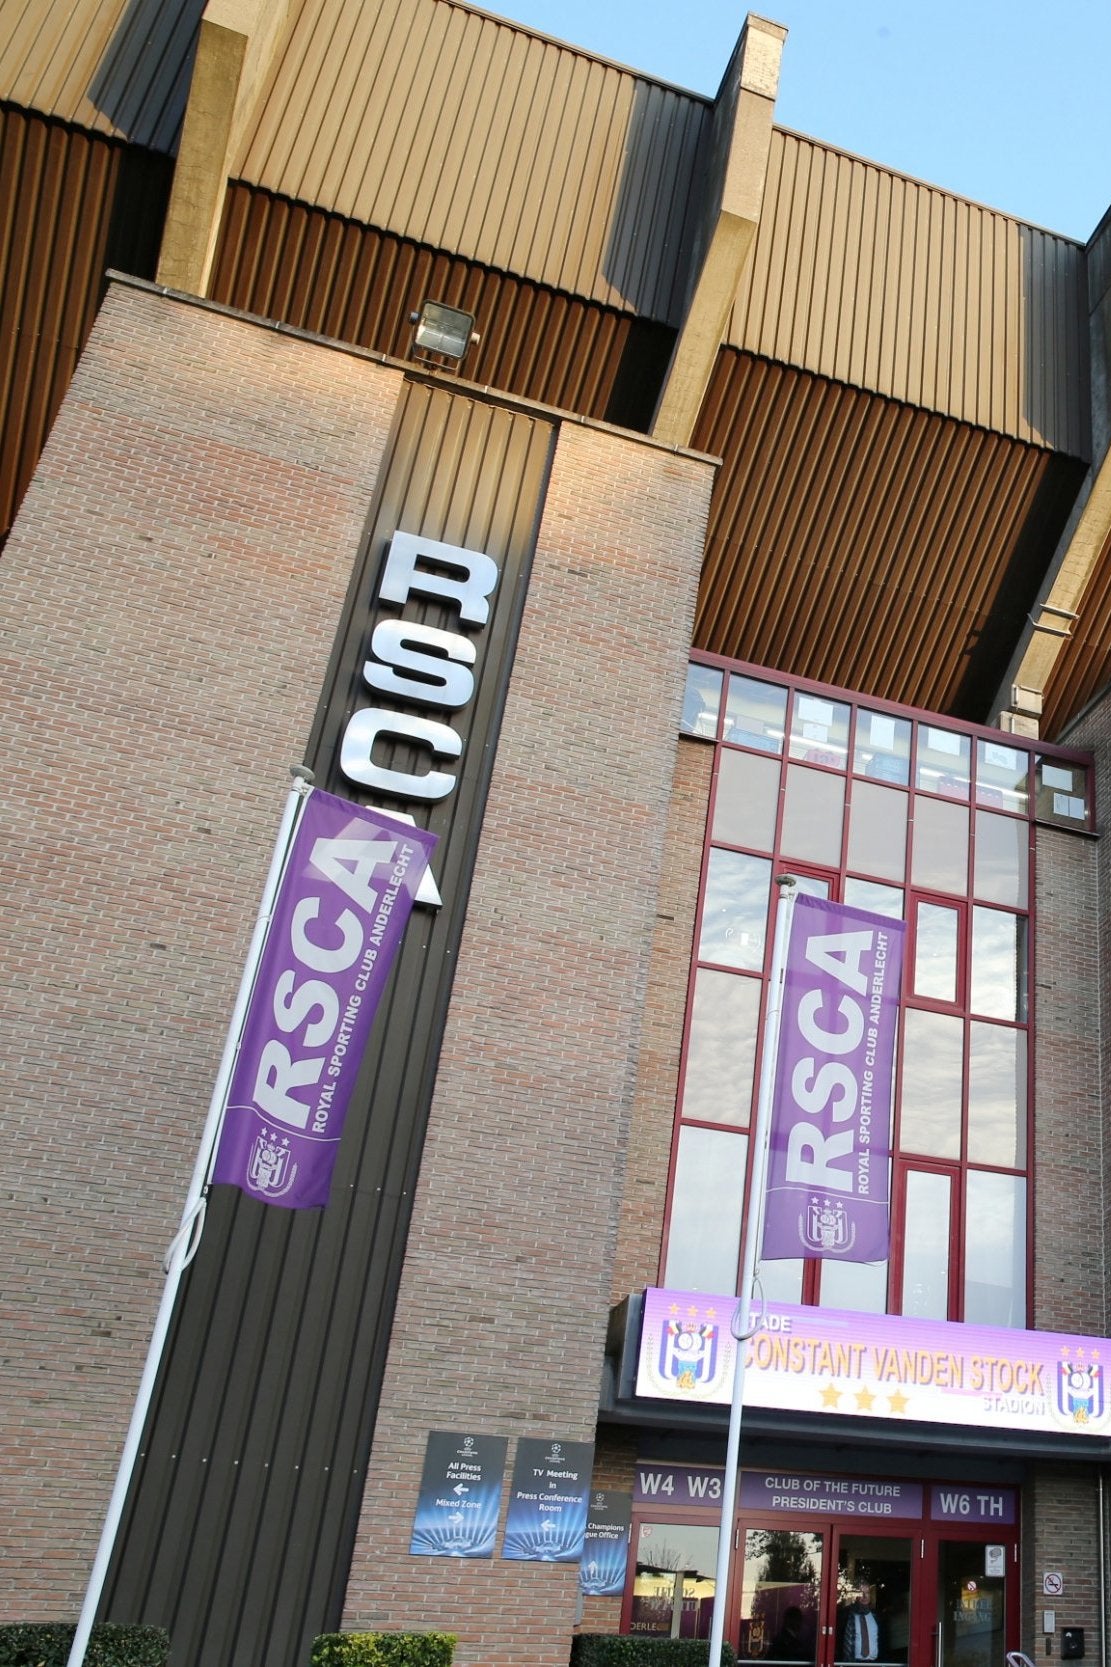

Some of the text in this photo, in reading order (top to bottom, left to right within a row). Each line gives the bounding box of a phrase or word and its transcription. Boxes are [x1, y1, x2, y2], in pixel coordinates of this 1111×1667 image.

[252, 837, 399, 1130] RSCA
[312, 843, 415, 1133] ROYAL SPORTING CLUB ANDERLECHT
[785, 930, 874, 1193] RSCA
[858, 931, 888, 1194] ROYAL SPORTING CLUB ANDERLECHT
[749, 1312, 792, 1333] TADE
[872, 1345, 965, 1389] VANDEN
[970, 1355, 1045, 1396] STOCK
[984, 1397, 1046, 1416] STADION
[446, 1471, 482, 1481] Facilities
[448, 1462, 482, 1472] All Press
[533, 1469, 579, 1481] TV Meeting
[640, 1472, 722, 1499] W4 W3
[765, 1477, 902, 1497] CLUB OF THE FUTURE
[435, 1498, 482, 1509] Mixed Zone
[516, 1491, 583, 1503] Press Conference
[772, 1495, 892, 1515] PRESIDENT'S CLUB
[939, 1492, 1003, 1517] W6 TH
[538, 1504, 562, 1512] Room
[588, 1522, 625, 1532] Champions
[598, 1531, 619, 1540] Office
